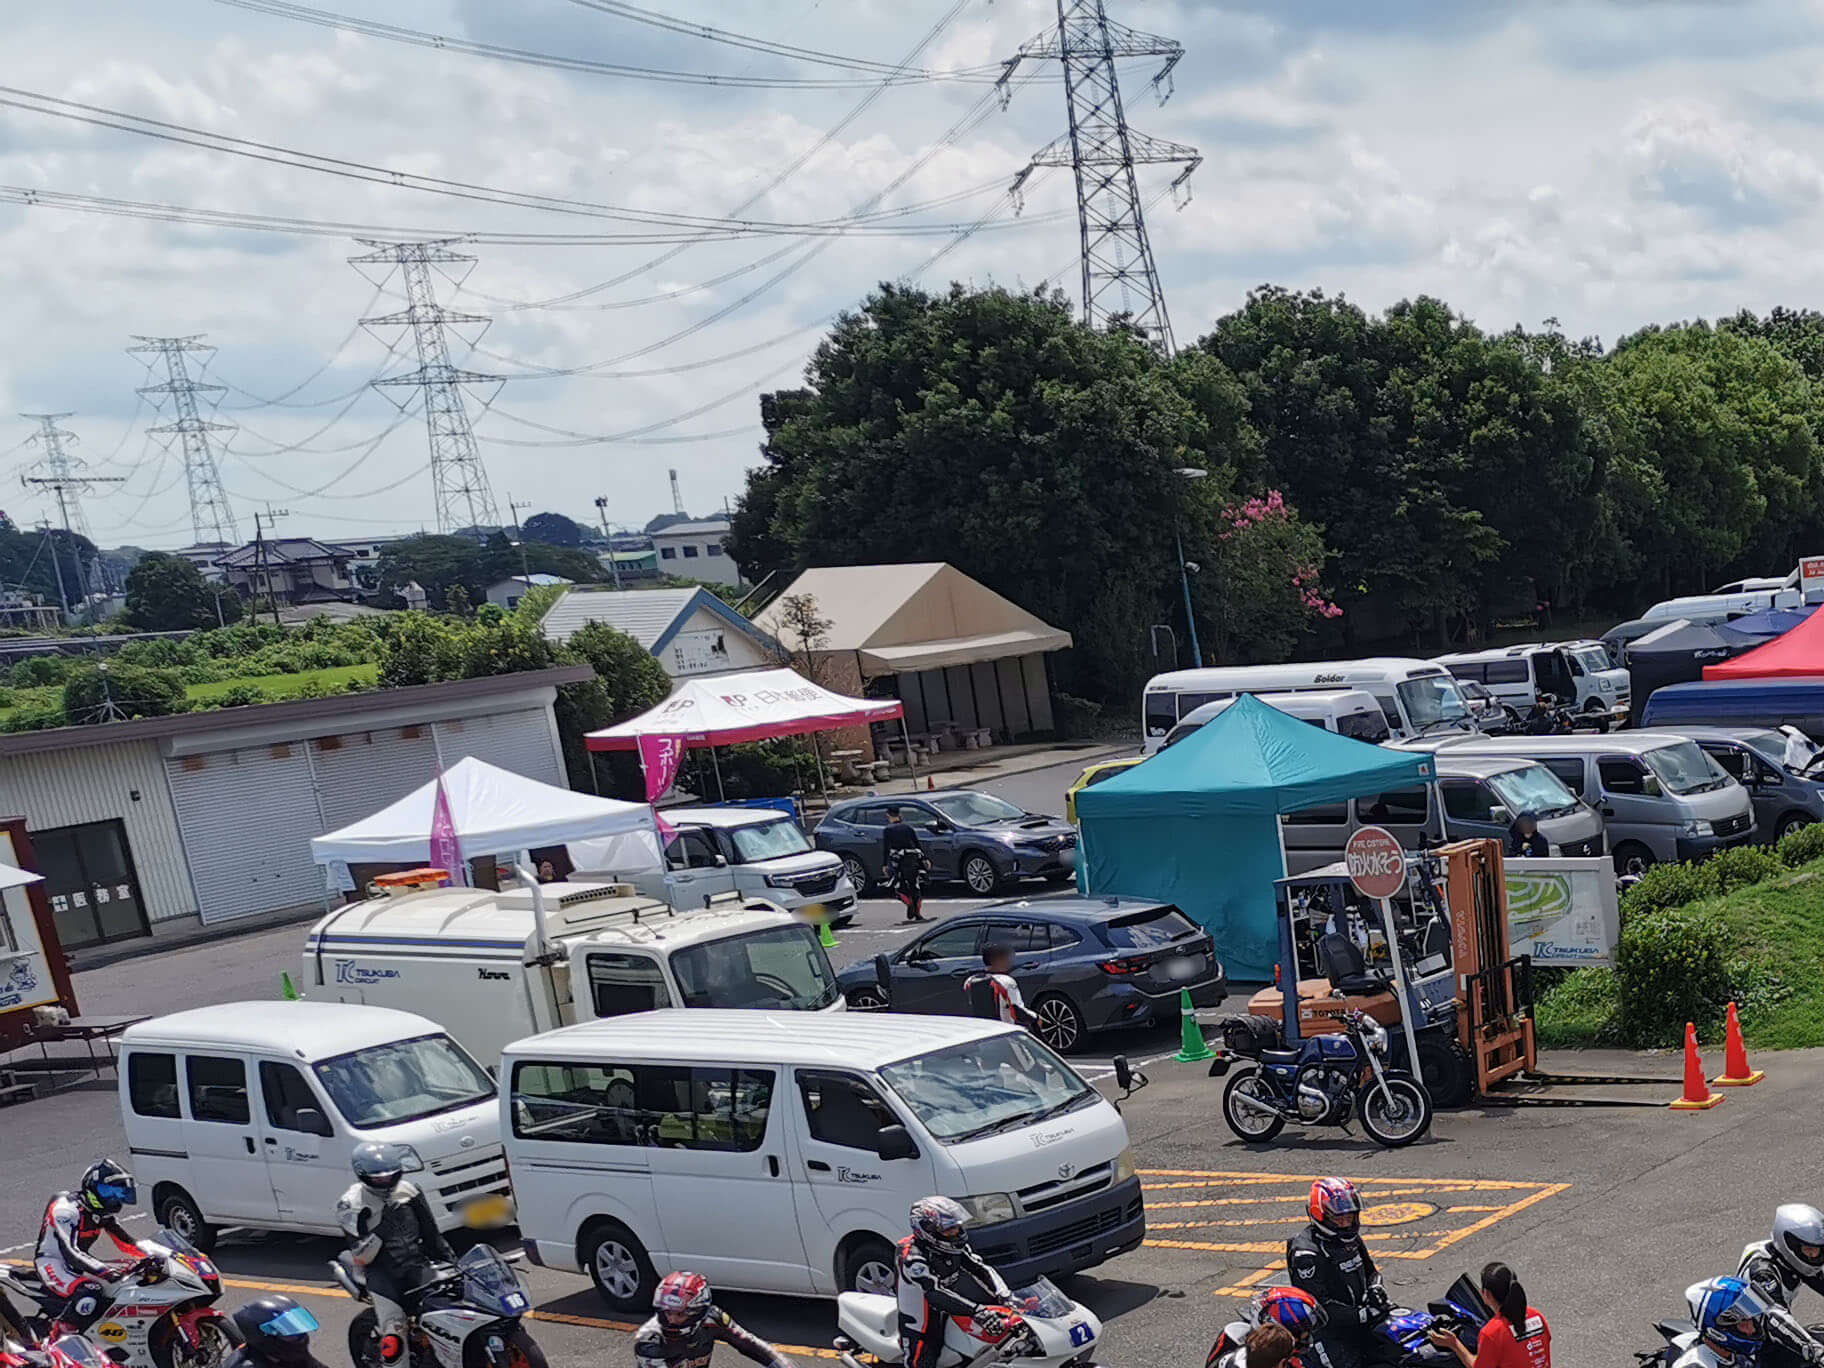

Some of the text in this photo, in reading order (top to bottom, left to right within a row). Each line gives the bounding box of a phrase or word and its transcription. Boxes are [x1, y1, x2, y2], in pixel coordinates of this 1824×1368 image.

[1348, 849, 1402, 877] 防火水そう
[355, 968, 400, 978] TSUKUBA
[1077, 1326, 1089, 1343] 2
